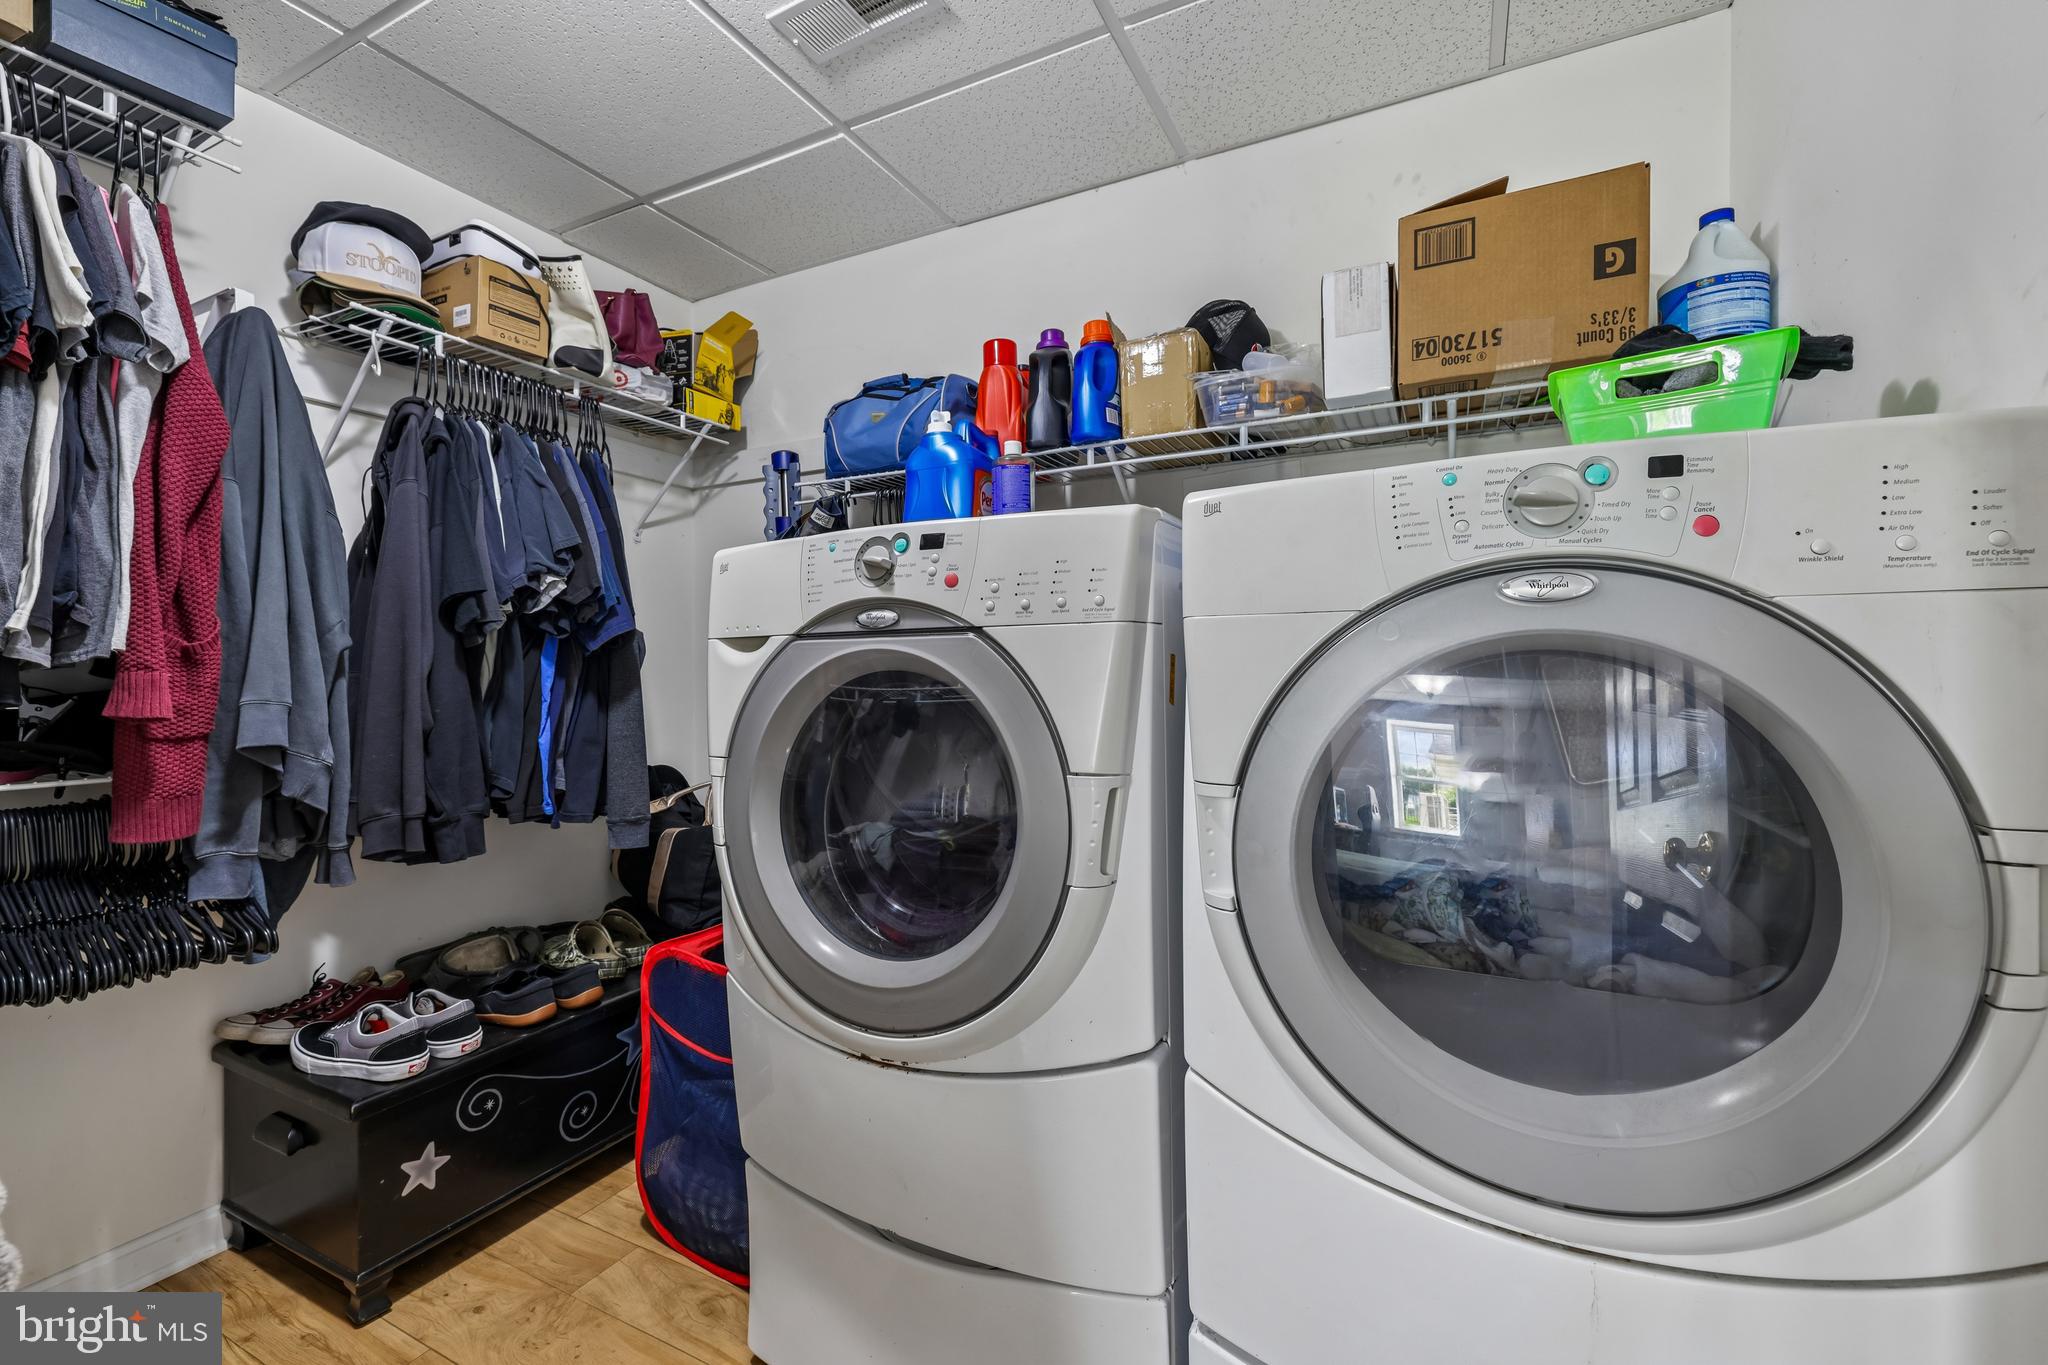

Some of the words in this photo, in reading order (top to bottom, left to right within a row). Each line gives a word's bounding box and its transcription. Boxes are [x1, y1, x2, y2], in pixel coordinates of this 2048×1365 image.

[1605, 246, 1624, 273] G
[1590, 306, 1636, 328] 3/33's
[1577, 328, 1614, 346] Count
[1441, 353, 1472, 367] 36000
[1204, 501, 1222, 516] duet
[1474, 542, 1505, 550] Automatic
[1528, 581, 1569, 590] Whirlpool
